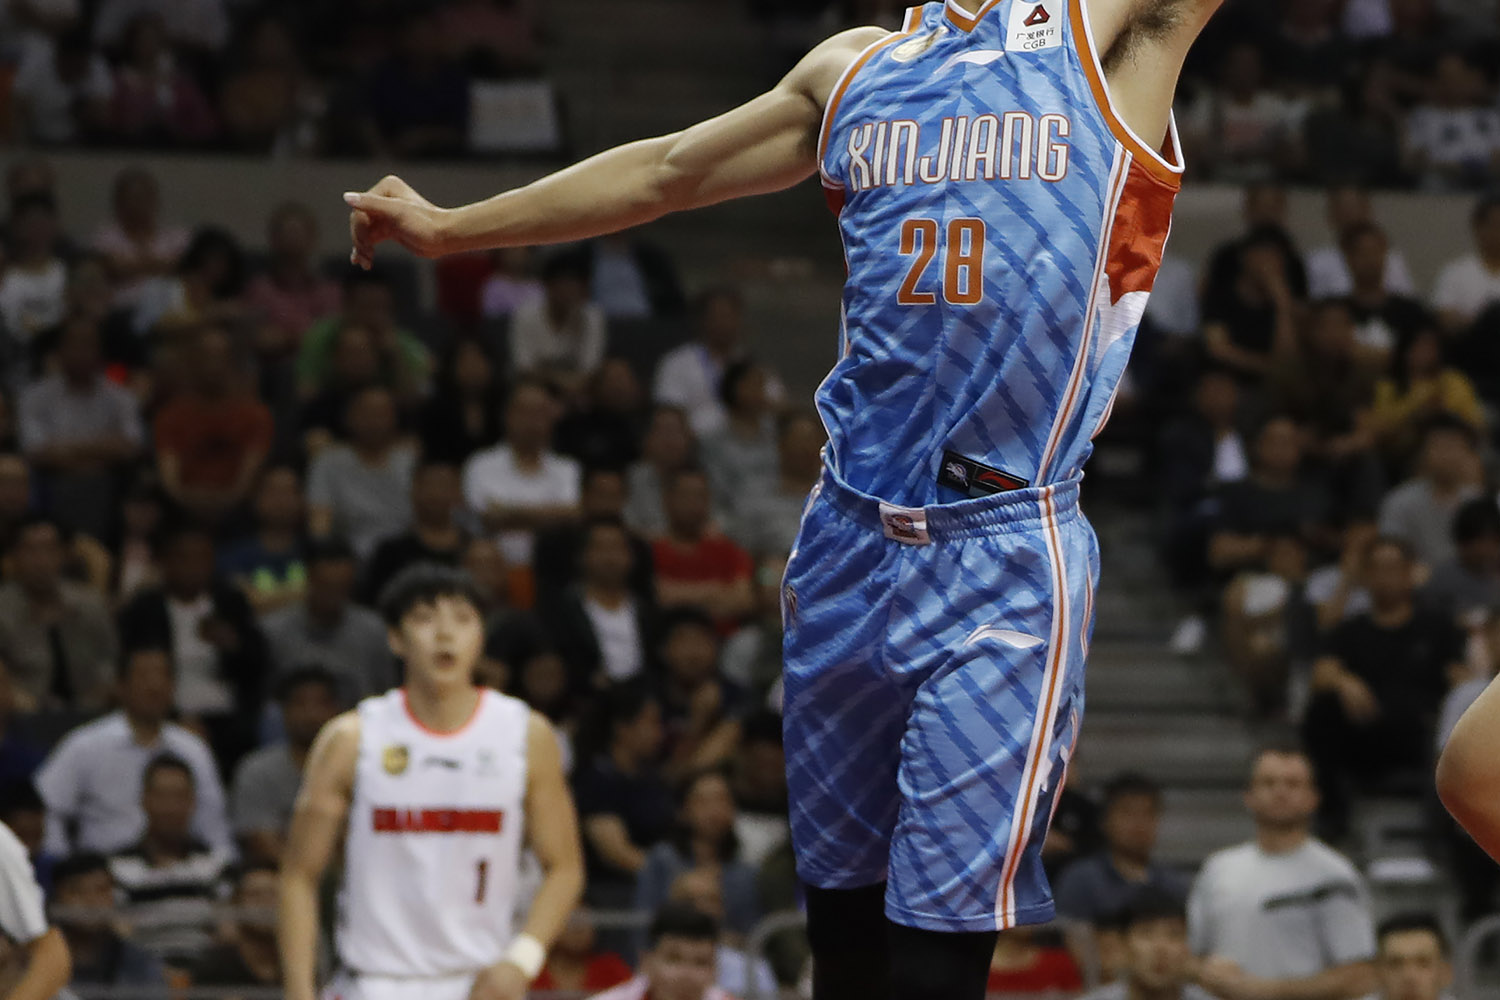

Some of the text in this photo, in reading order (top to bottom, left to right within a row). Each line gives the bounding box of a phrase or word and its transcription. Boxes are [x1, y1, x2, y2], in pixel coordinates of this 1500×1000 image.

[1023, 38, 1046, 50] CGB
[847, 110, 1071, 193] XINJIANG
[896, 216, 987, 306] 28
[474, 858, 488, 904] 1
